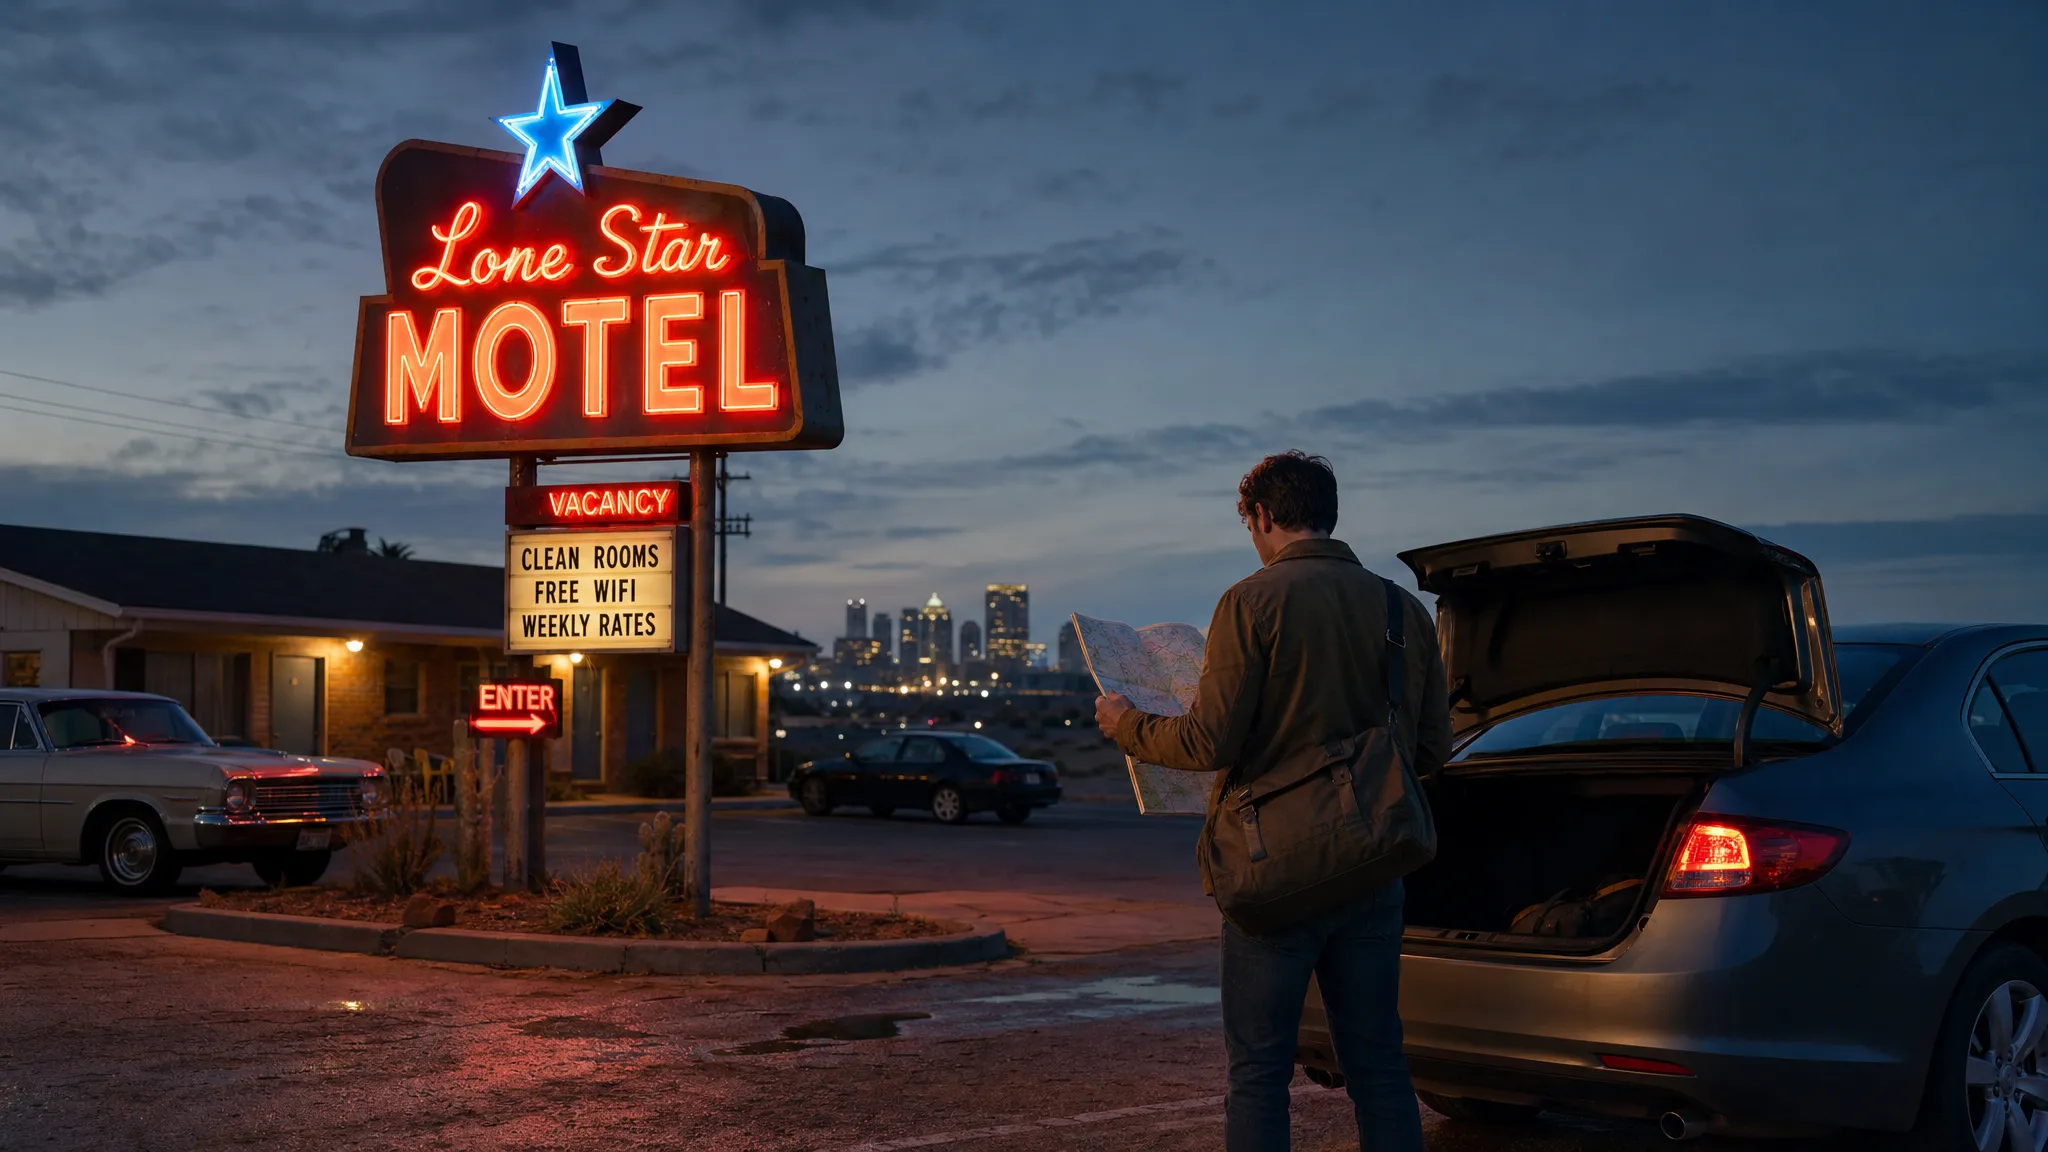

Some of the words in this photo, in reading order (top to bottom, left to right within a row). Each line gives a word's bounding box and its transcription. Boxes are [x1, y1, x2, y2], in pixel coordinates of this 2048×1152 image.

[411, 202, 573, 289] Lone
[593, 204, 731, 278] Star
[385, 290, 779, 425] MOTEL
[549, 489, 671, 516] VACANCY
[521, 547, 580, 571] CLEAN
[594, 545, 659, 568] ROOMS
[535, 580, 579, 604] FREE
[594, 579, 636, 603] WIFI
[522, 614, 590, 638] WEEKLY
[599, 612, 656, 636] RATES
[479, 684, 555, 711] ENTER
